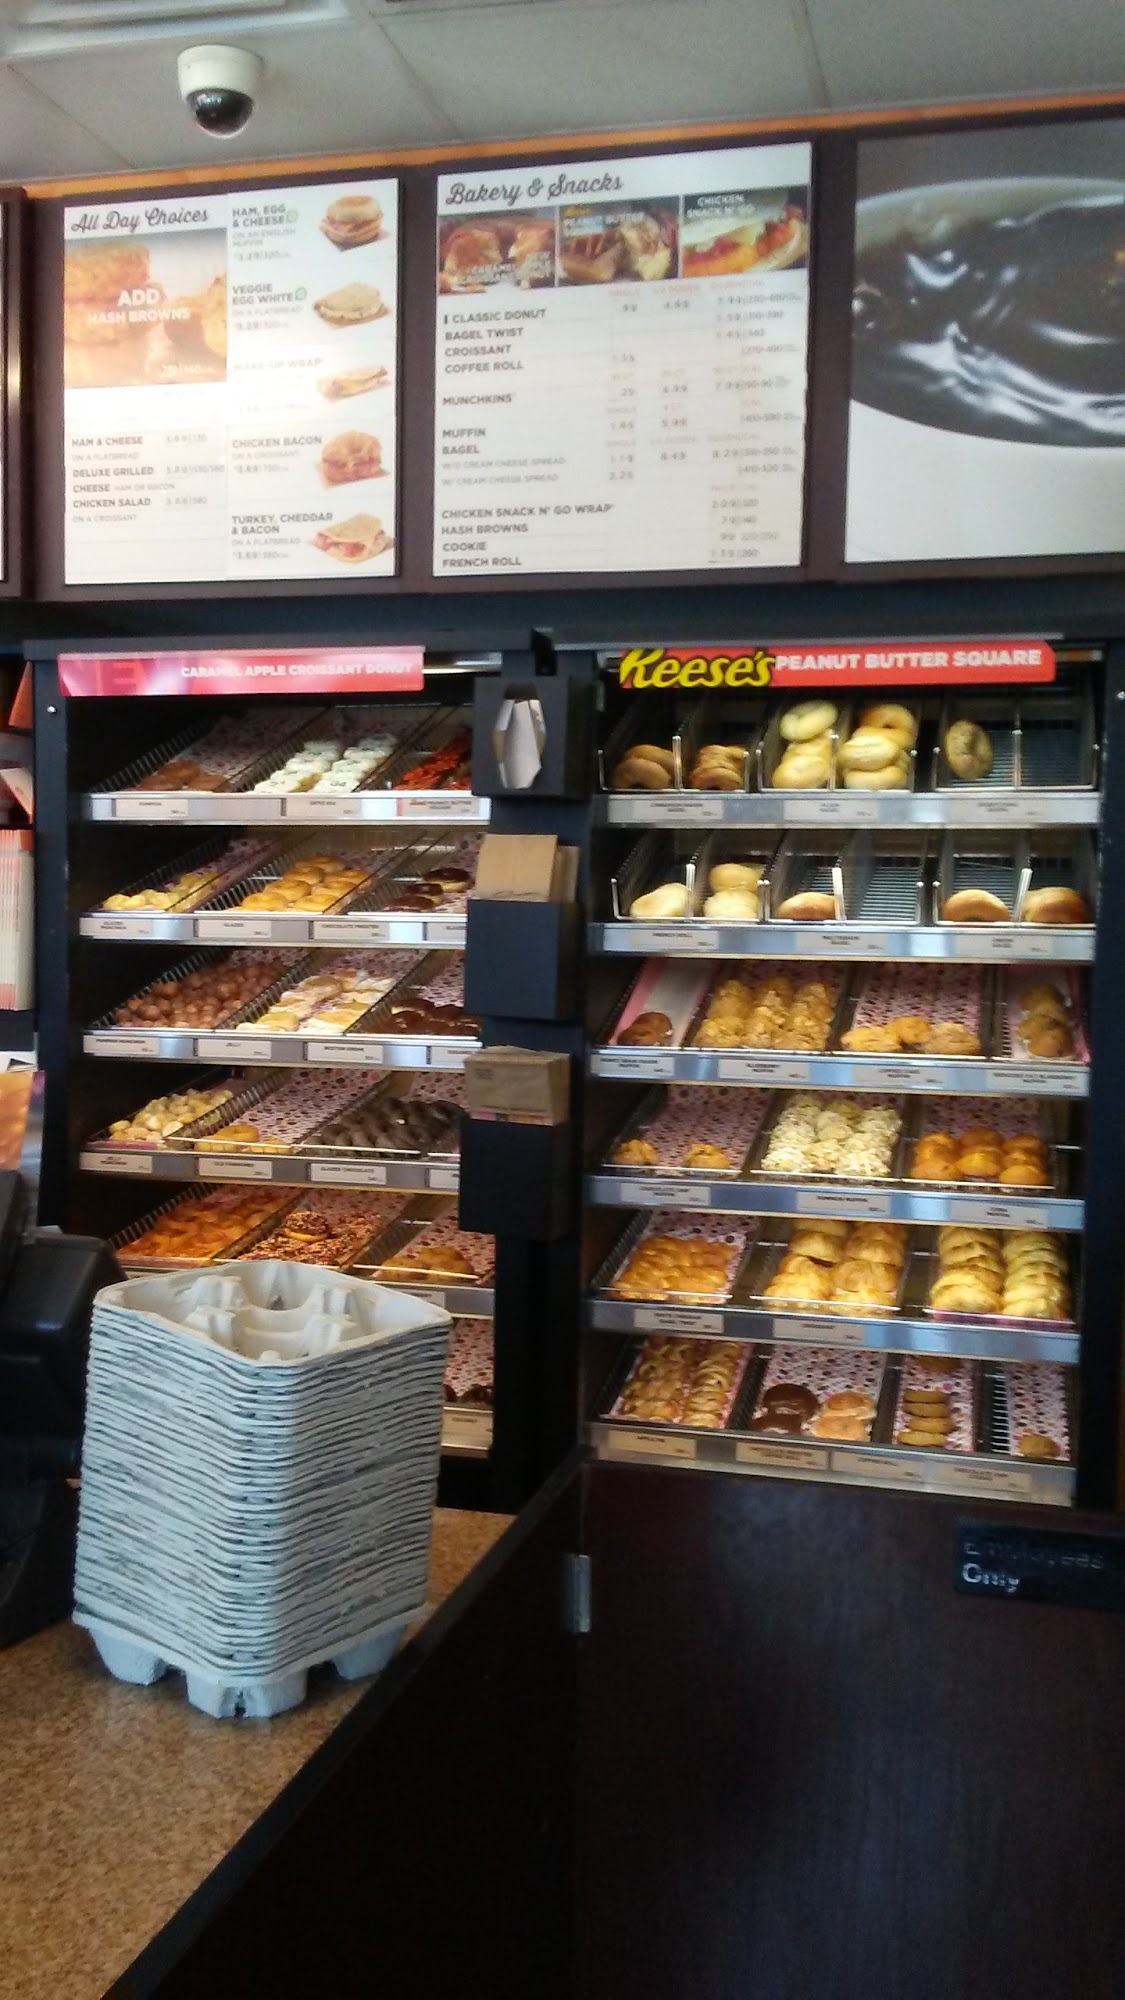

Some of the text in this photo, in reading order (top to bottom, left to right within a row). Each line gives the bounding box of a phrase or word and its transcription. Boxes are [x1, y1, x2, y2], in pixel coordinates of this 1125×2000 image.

[446, 173, 624, 206] Bakery & Snacks
[232, 204, 286, 217] HAM, EGG
[71, 206, 209, 234] All Day Choices
[232, 215, 285, 228] & CHEESE
[232, 283, 273, 295] VEGGIE
[117, 287, 161, 307] ADD
[232, 292, 293, 306] EGG WHITE
[88, 306, 191, 325] HASH BROWNS
[452, 311, 501, 324] CLASSIC
[504, 309, 547, 321] DONUT
[445, 327, 525, 341] BAGEL TWIST
[444, 344, 512, 357] CROISSANT
[444, 360, 525, 374] COFFEE ROLL
[442, 427, 487, 438] MUFFIN
[71, 436, 144, 447] HAM & CHEESE
[232, 435, 323, 449] CHICKEN BACON
[442, 444, 480, 455] BAGEL
[73, 467, 111, 478] DELUXE
[113, 466, 155, 476] GRILLED
[73, 483, 111, 493] CHEESE
[73, 497, 152, 508] CHICKEN SALAD
[231, 512, 333, 525] TURKEY, CHEDDAR
[442, 508, 494, 519] CHICKEN
[496, 506, 535, 517] SNACK
[553, 505, 572, 515] GO
[231, 525, 280, 535] & BACON
[442, 523, 529, 535] HASH BROWNS
[442, 541, 488, 551] COOKIE
[442, 556, 522, 568] FRENCH ROLL
[181, 661, 412, 678] CARAMEL APPLE CROISSANT DONUT
[619, 648, 1042, 688] Reese's PEANUT BUTTER SQUARE
